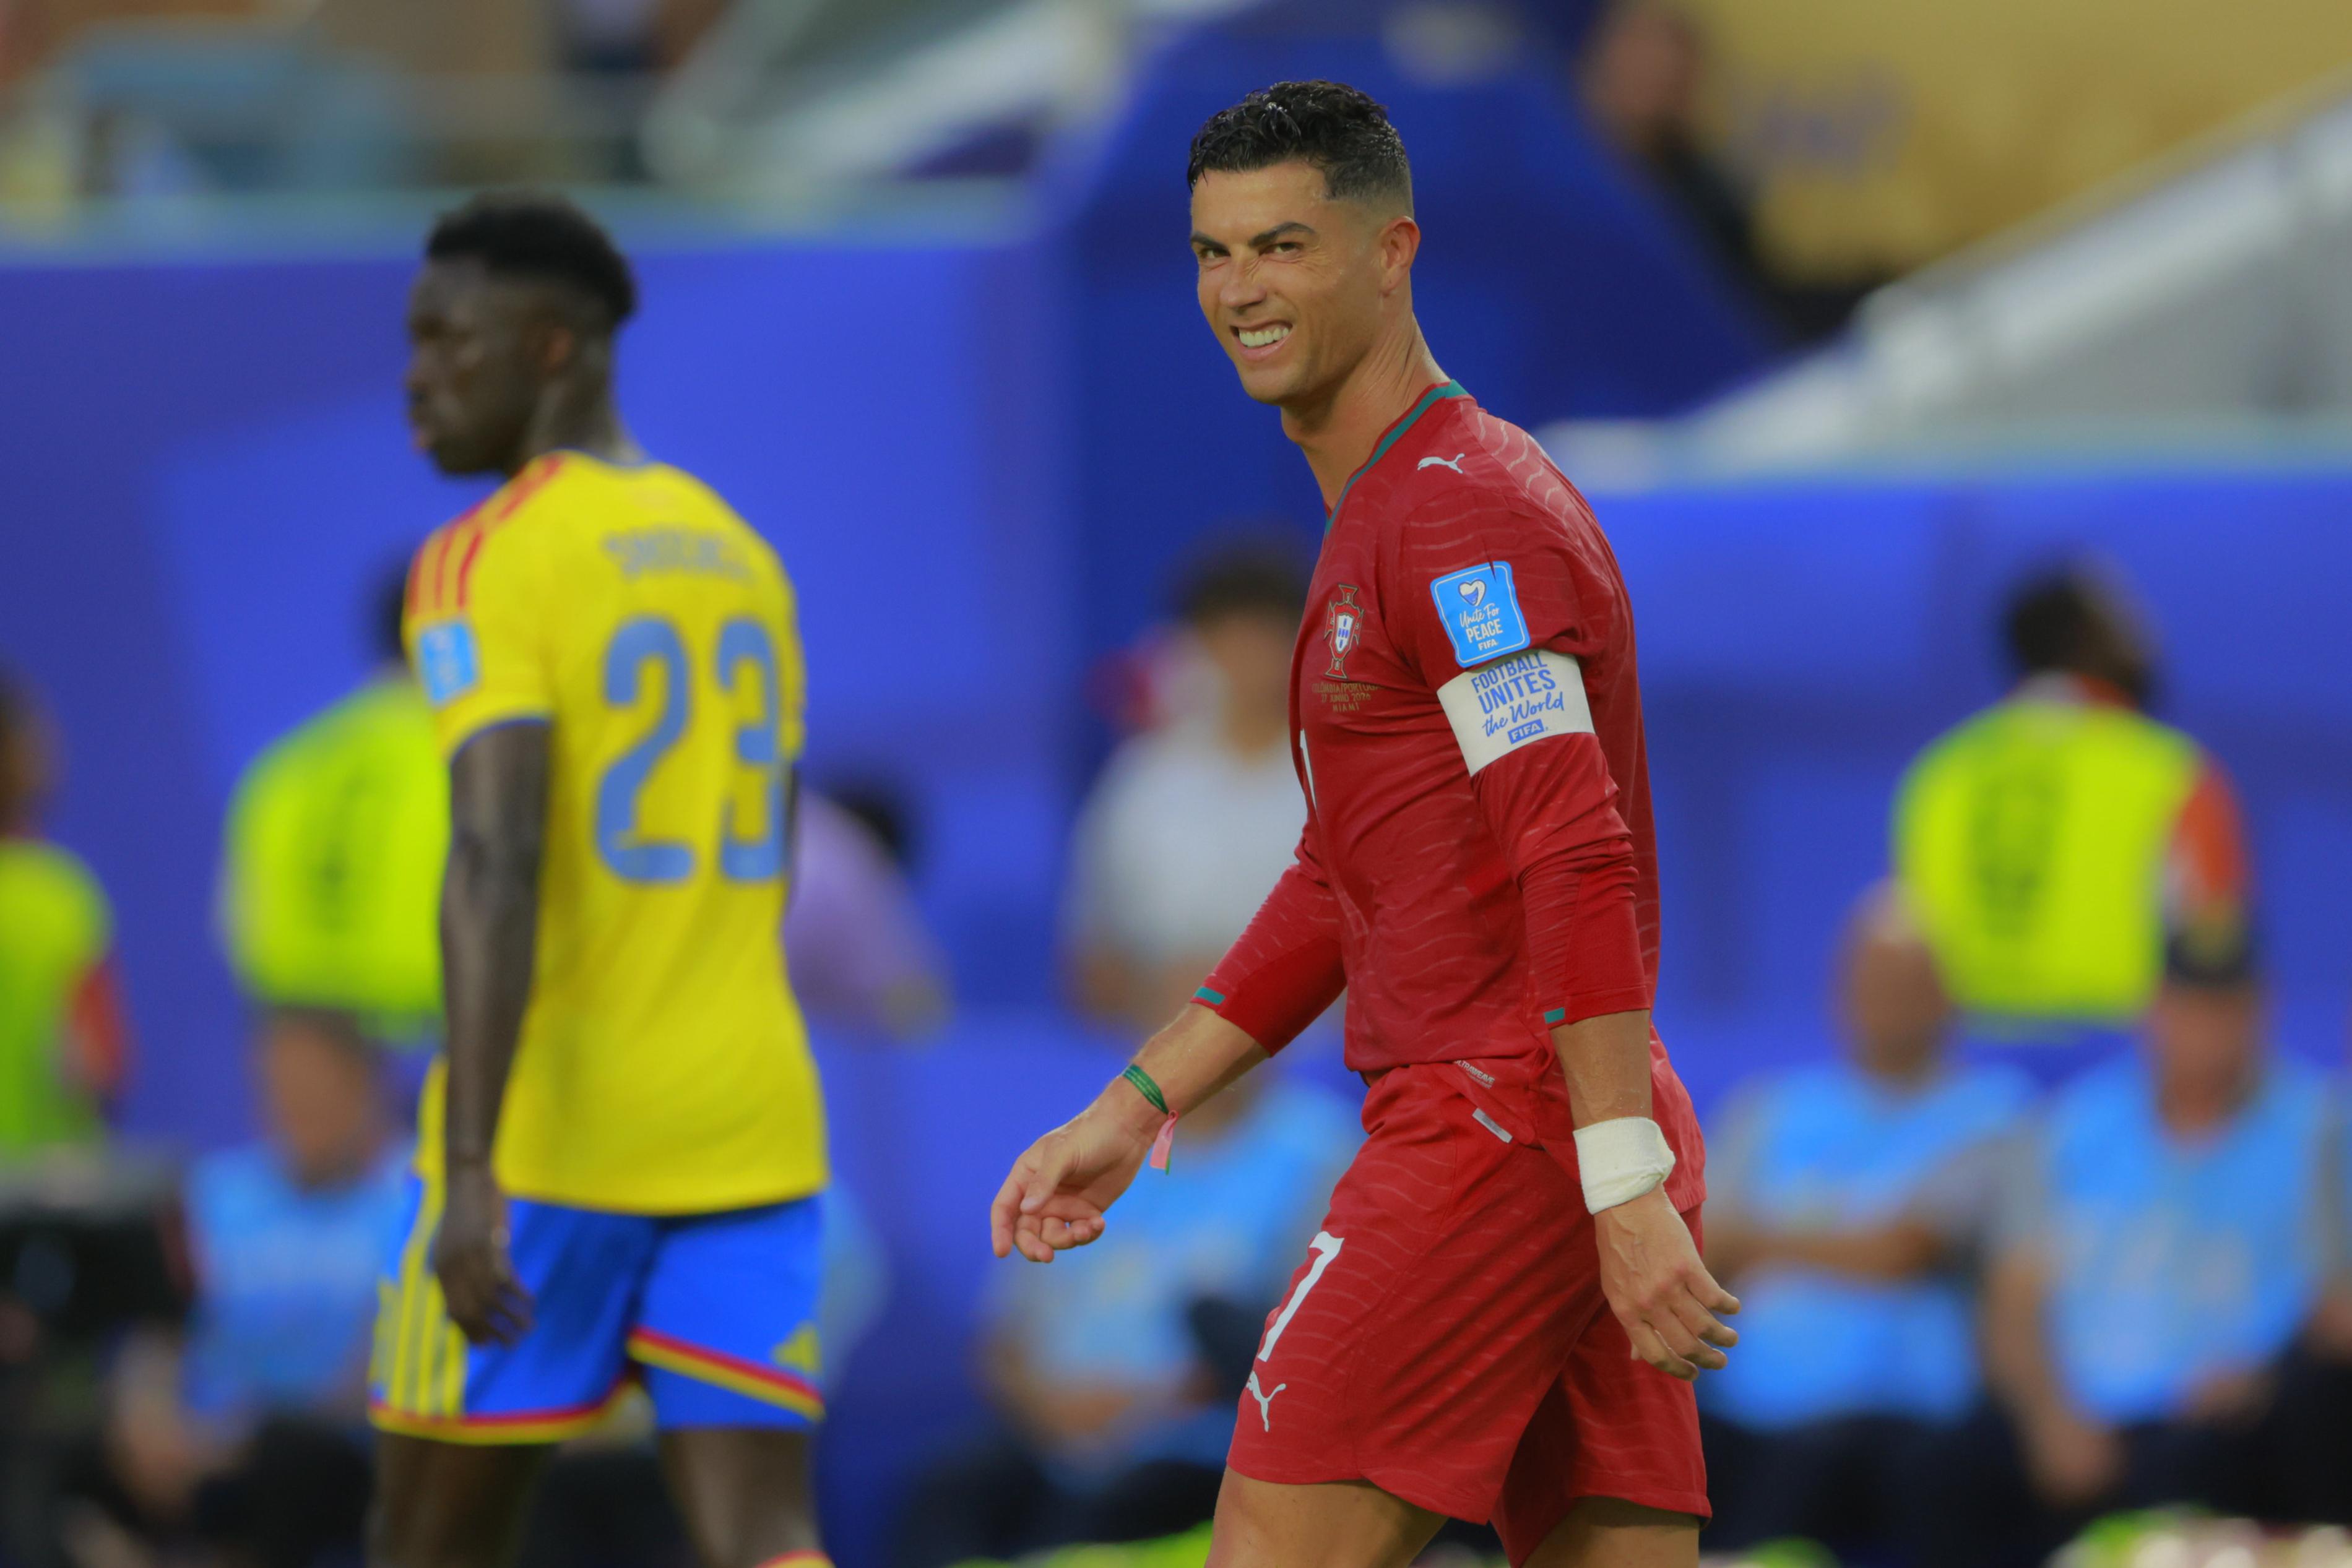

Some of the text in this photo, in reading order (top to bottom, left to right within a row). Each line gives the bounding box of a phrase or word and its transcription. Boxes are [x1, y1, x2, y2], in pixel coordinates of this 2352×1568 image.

[1459, 603, 1500, 627] Unite For
[1466, 618, 1503, 643] PEACE
[1478, 639, 1498, 651] FIFA
[1471, 653, 1547, 694] FOOTBALL
[1333, 702, 1359, 712] MIAMI
[1478, 670, 1555, 714] UNITES
[1482, 691, 1564, 737] the World
[1510, 722, 1541, 741] FIFA
[594, 613, 785, 884] 23
[1258, 1231, 1345, 1362] 7
